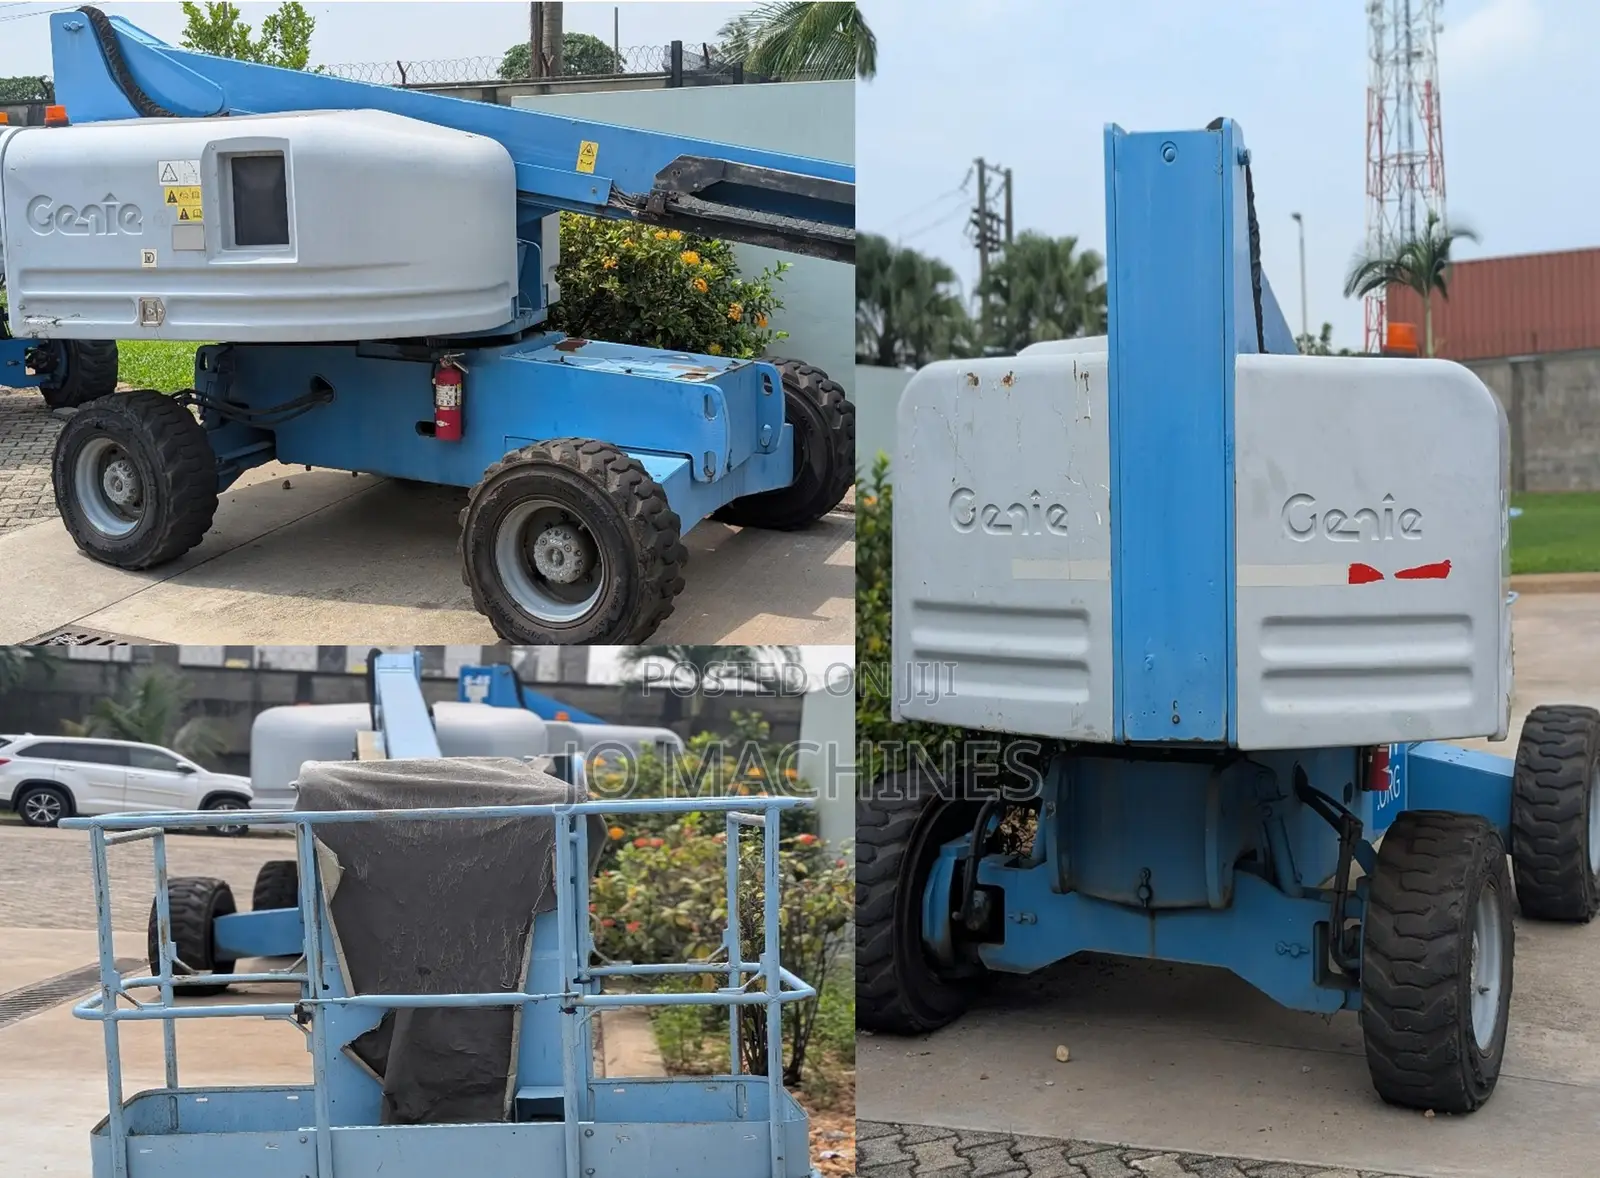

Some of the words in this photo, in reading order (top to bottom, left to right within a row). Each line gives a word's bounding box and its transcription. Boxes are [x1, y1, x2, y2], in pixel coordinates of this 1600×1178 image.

[26, 192, 143, 236] Genie
[949, 487, 1069, 536] Genie
[1281, 492, 1423, 542] Genie
